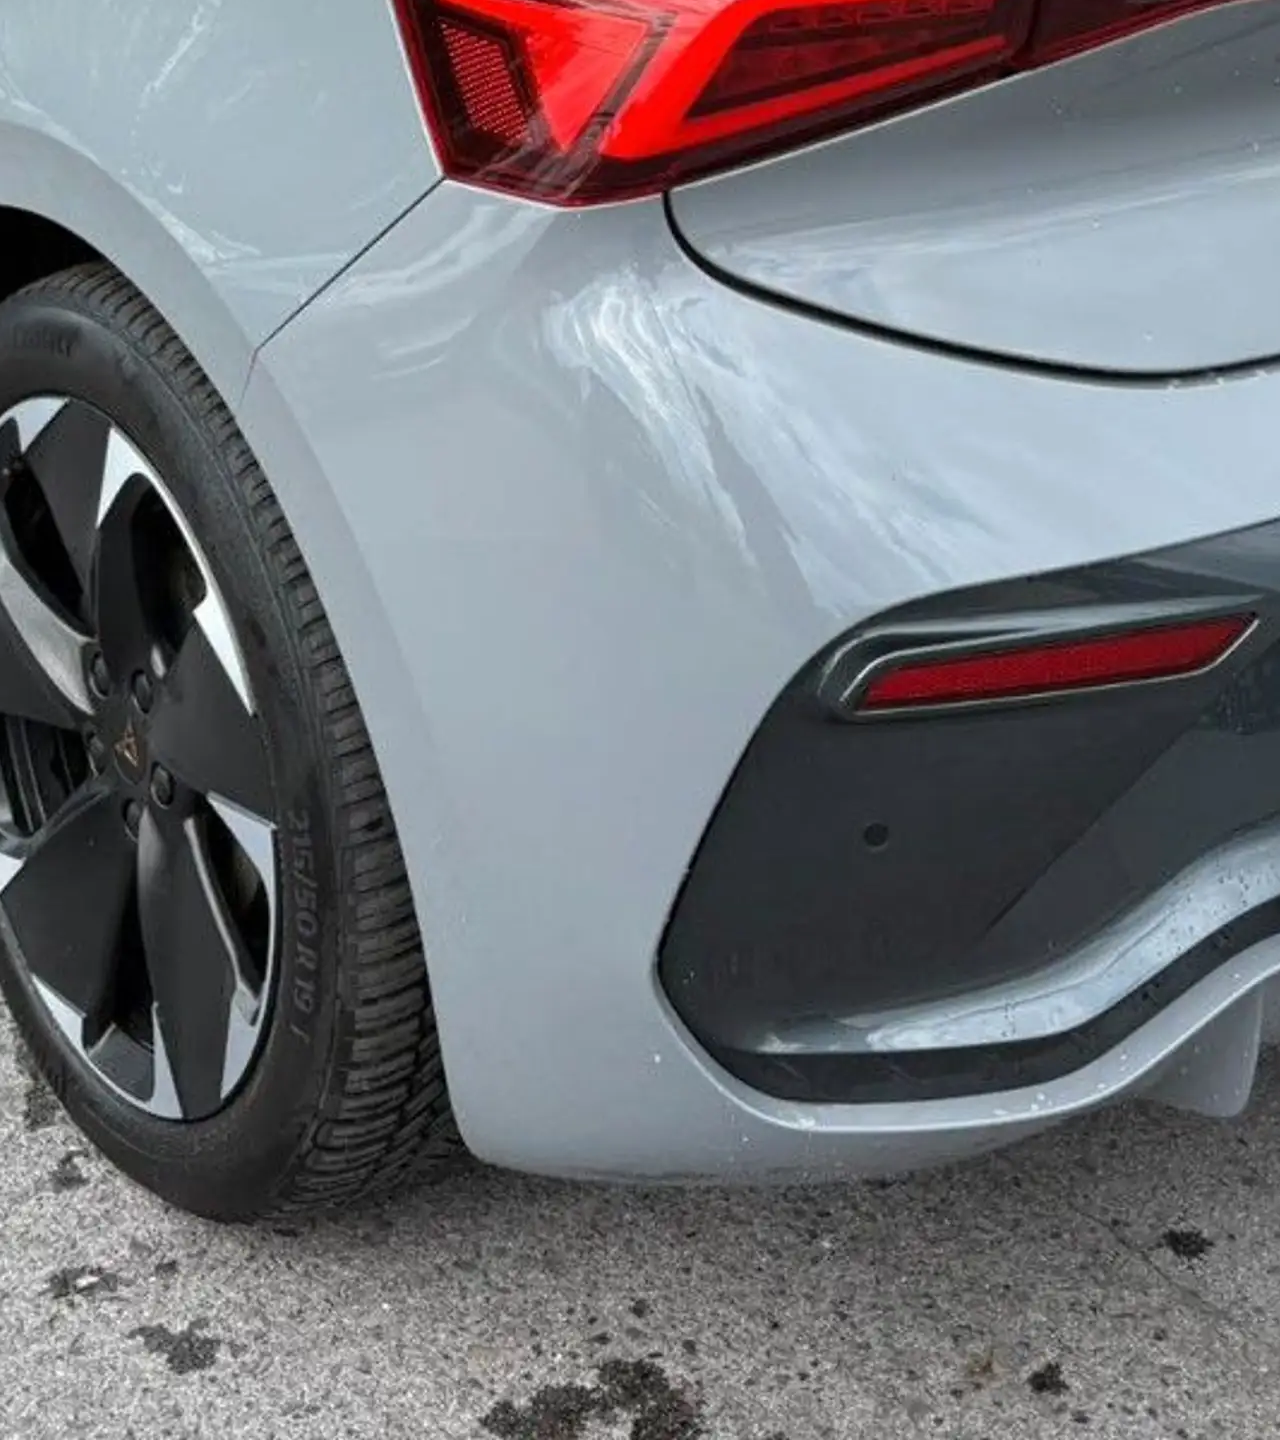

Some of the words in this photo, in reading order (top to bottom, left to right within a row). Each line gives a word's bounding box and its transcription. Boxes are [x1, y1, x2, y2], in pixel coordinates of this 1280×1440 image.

[285, 807, 321, 935] 215/50
[294, 940, 316, 967] R
[292, 974, 317, 1015] 19
